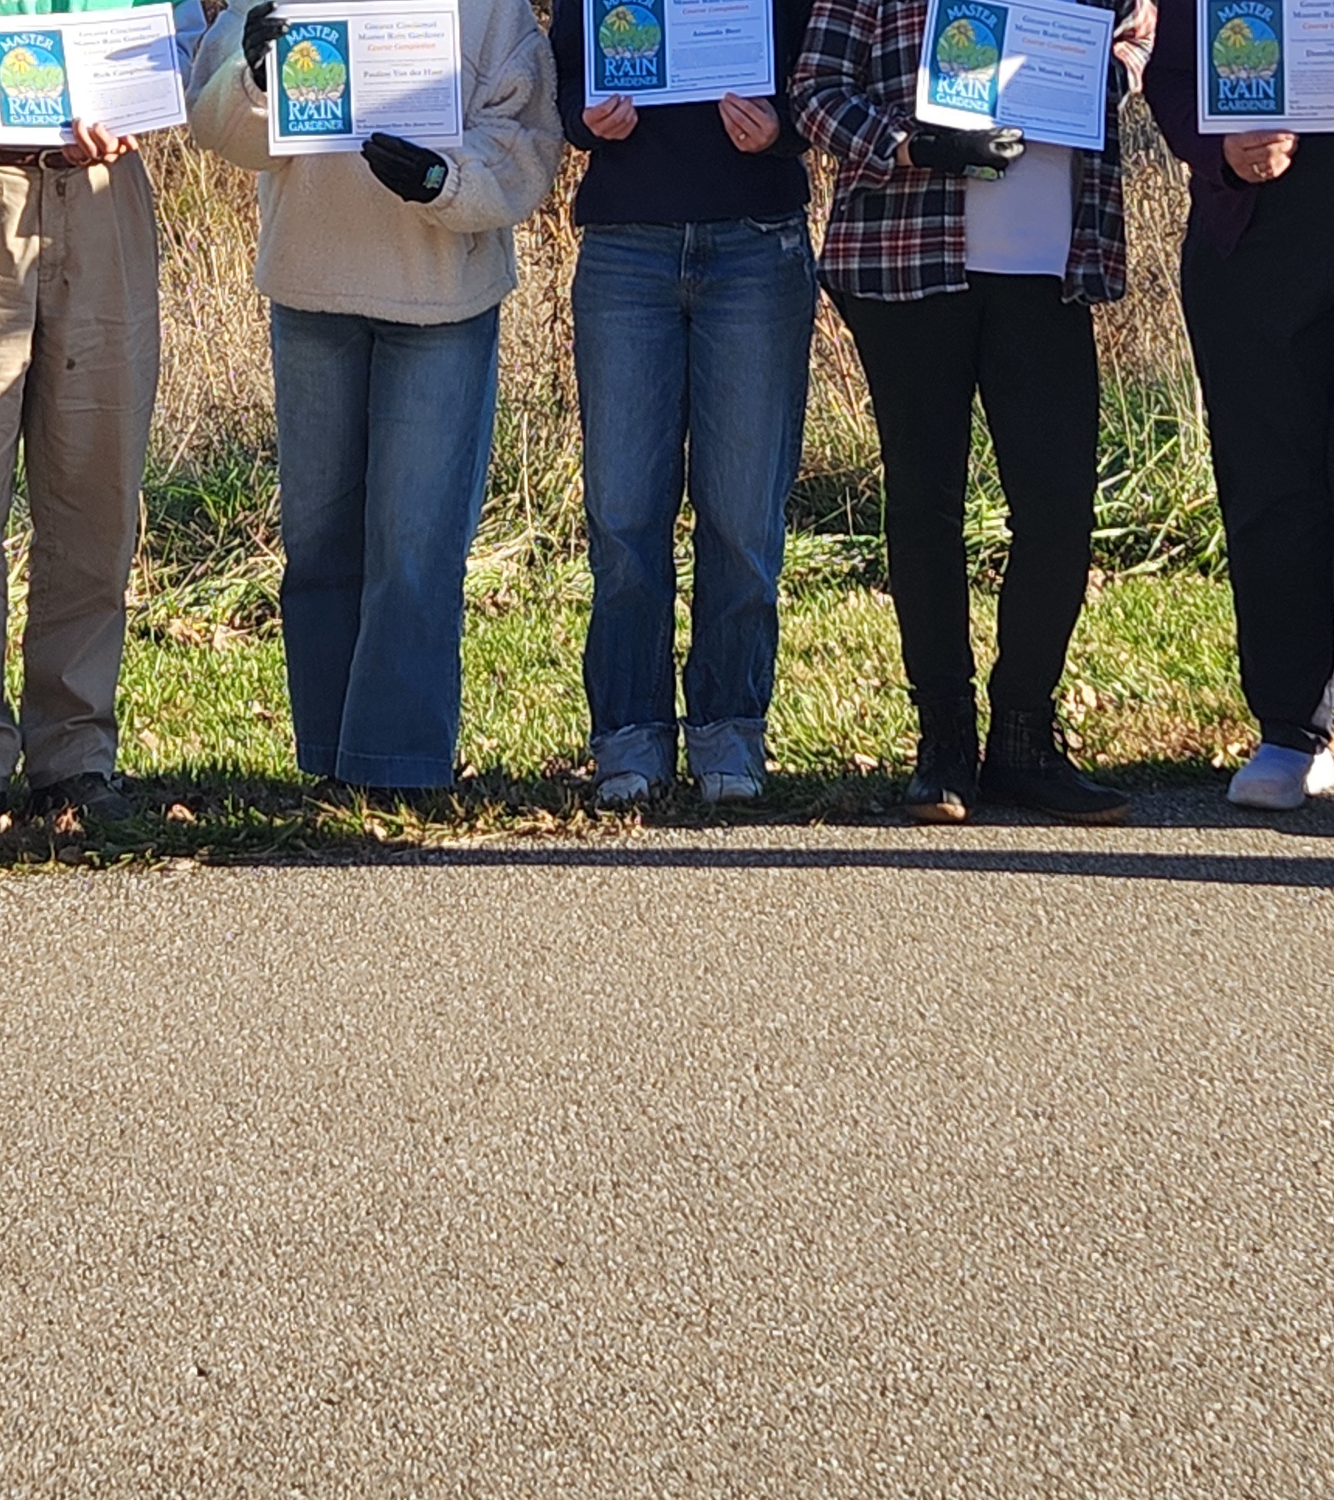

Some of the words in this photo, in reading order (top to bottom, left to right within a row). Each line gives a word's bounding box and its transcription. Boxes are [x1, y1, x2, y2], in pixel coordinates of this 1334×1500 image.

[947, 4, 997, 28] MASTER
[1217, 2, 1273, 22] MASTER
[0, 34, 54, 52] MASTER
[285, 25, 340, 46] MASTER
[605, 57, 657, 76] RAIN
[604, 77, 658, 87] GARDENER
[937, 75, 991, 101] RAIN
[1219, 79, 1275, 99] RAIN
[9, 96, 63, 115] RAIN
[288, 99, 342, 120] RAIN
[936, 93, 989, 112] GARDENER
[1218, 99, 1275, 110] GARDENER
[10, 114, 65, 124] GARDENER
[289, 119, 343, 131] GARDENER
